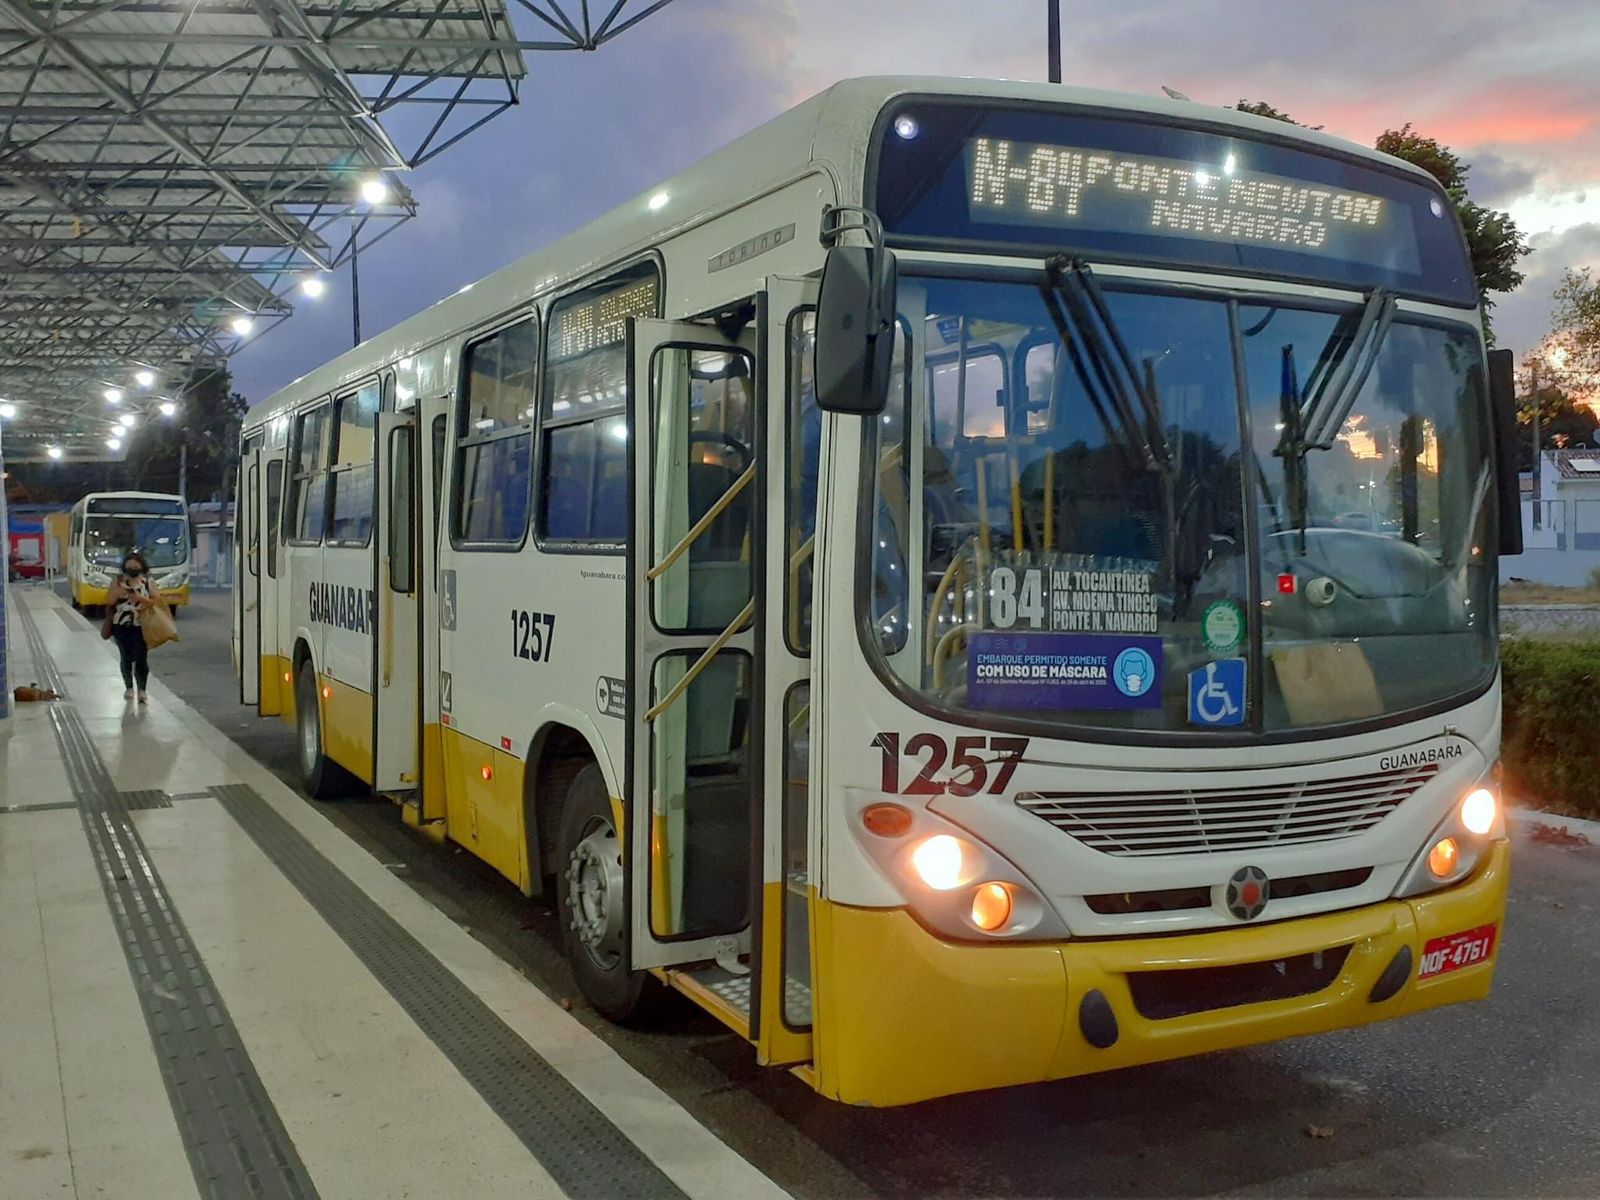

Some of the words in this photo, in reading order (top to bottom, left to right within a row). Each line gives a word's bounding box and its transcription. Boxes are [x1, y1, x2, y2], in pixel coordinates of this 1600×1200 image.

[973, 138, 1082, 215] N-84
[1086, 156, 1221, 201] PONTE
[1229, 178, 1382, 225] NEWTON
[1151, 199, 1327, 247] NAVARRO
[719, 230, 782, 267] TORINO
[990, 566, 1045, 628] 84
[1053, 571, 1072, 590] AV.
[1053, 591, 1071, 610] AV.
[1072, 591, 1114, 611] MOEMA
[1116, 593, 1158, 613] TINOCO
[511, 609, 556, 663] 1257
[1053, 611, 1090, 630] PONTE
[1092, 611, 1103, 631] N.
[1105, 612, 1158, 632] NAVARRO
[976, 665, 1003, 677] COM
[1005, 665, 1030, 678] USO
[1031, 665, 1048, 678] DE
[1049, 663, 1107, 678] MÁSCARA
[977, 654, 1024, 665] EMBARQUE
[1024, 655, 1068, 665] PERMITIDO
[1069, 656, 1108, 665] SOMENTE
[870, 732, 1030, 797] 1257
[1379, 744, 1463, 771] GUANABARA
